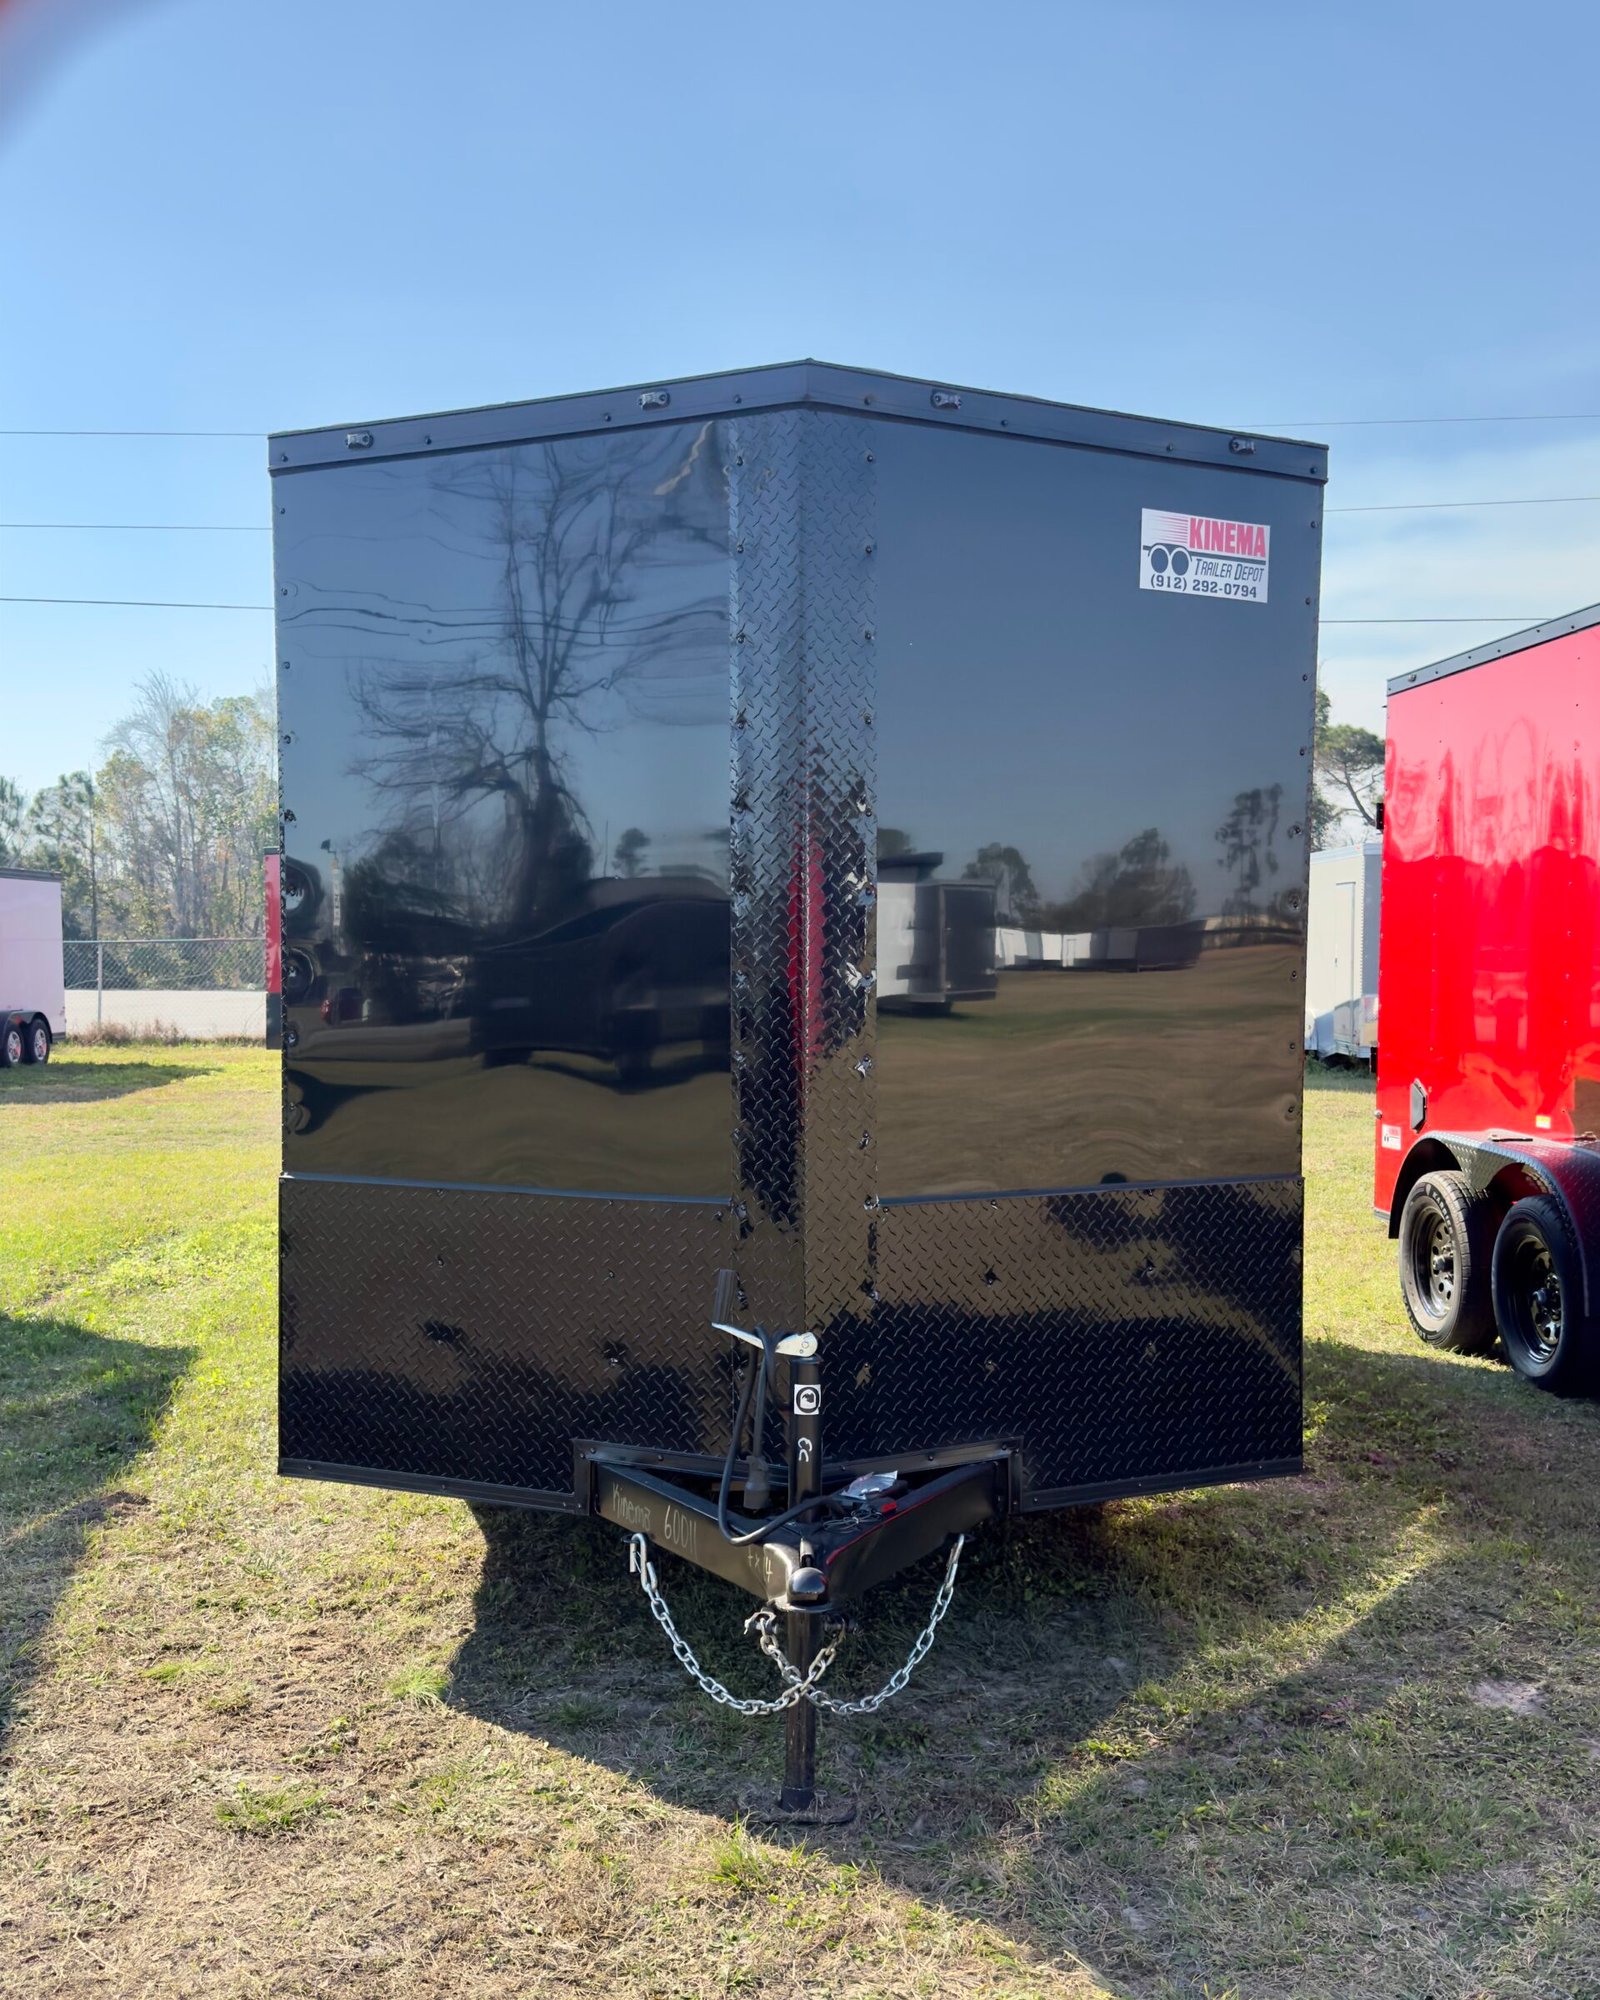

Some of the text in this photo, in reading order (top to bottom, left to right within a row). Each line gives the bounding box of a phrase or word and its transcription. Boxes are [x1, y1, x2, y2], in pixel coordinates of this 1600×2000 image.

[1189, 517, 1266, 559] KINEMA
[1234, 563, 1265, 583] DEPOT
[1150, 574, 1257, 598] (912) 292-0794
